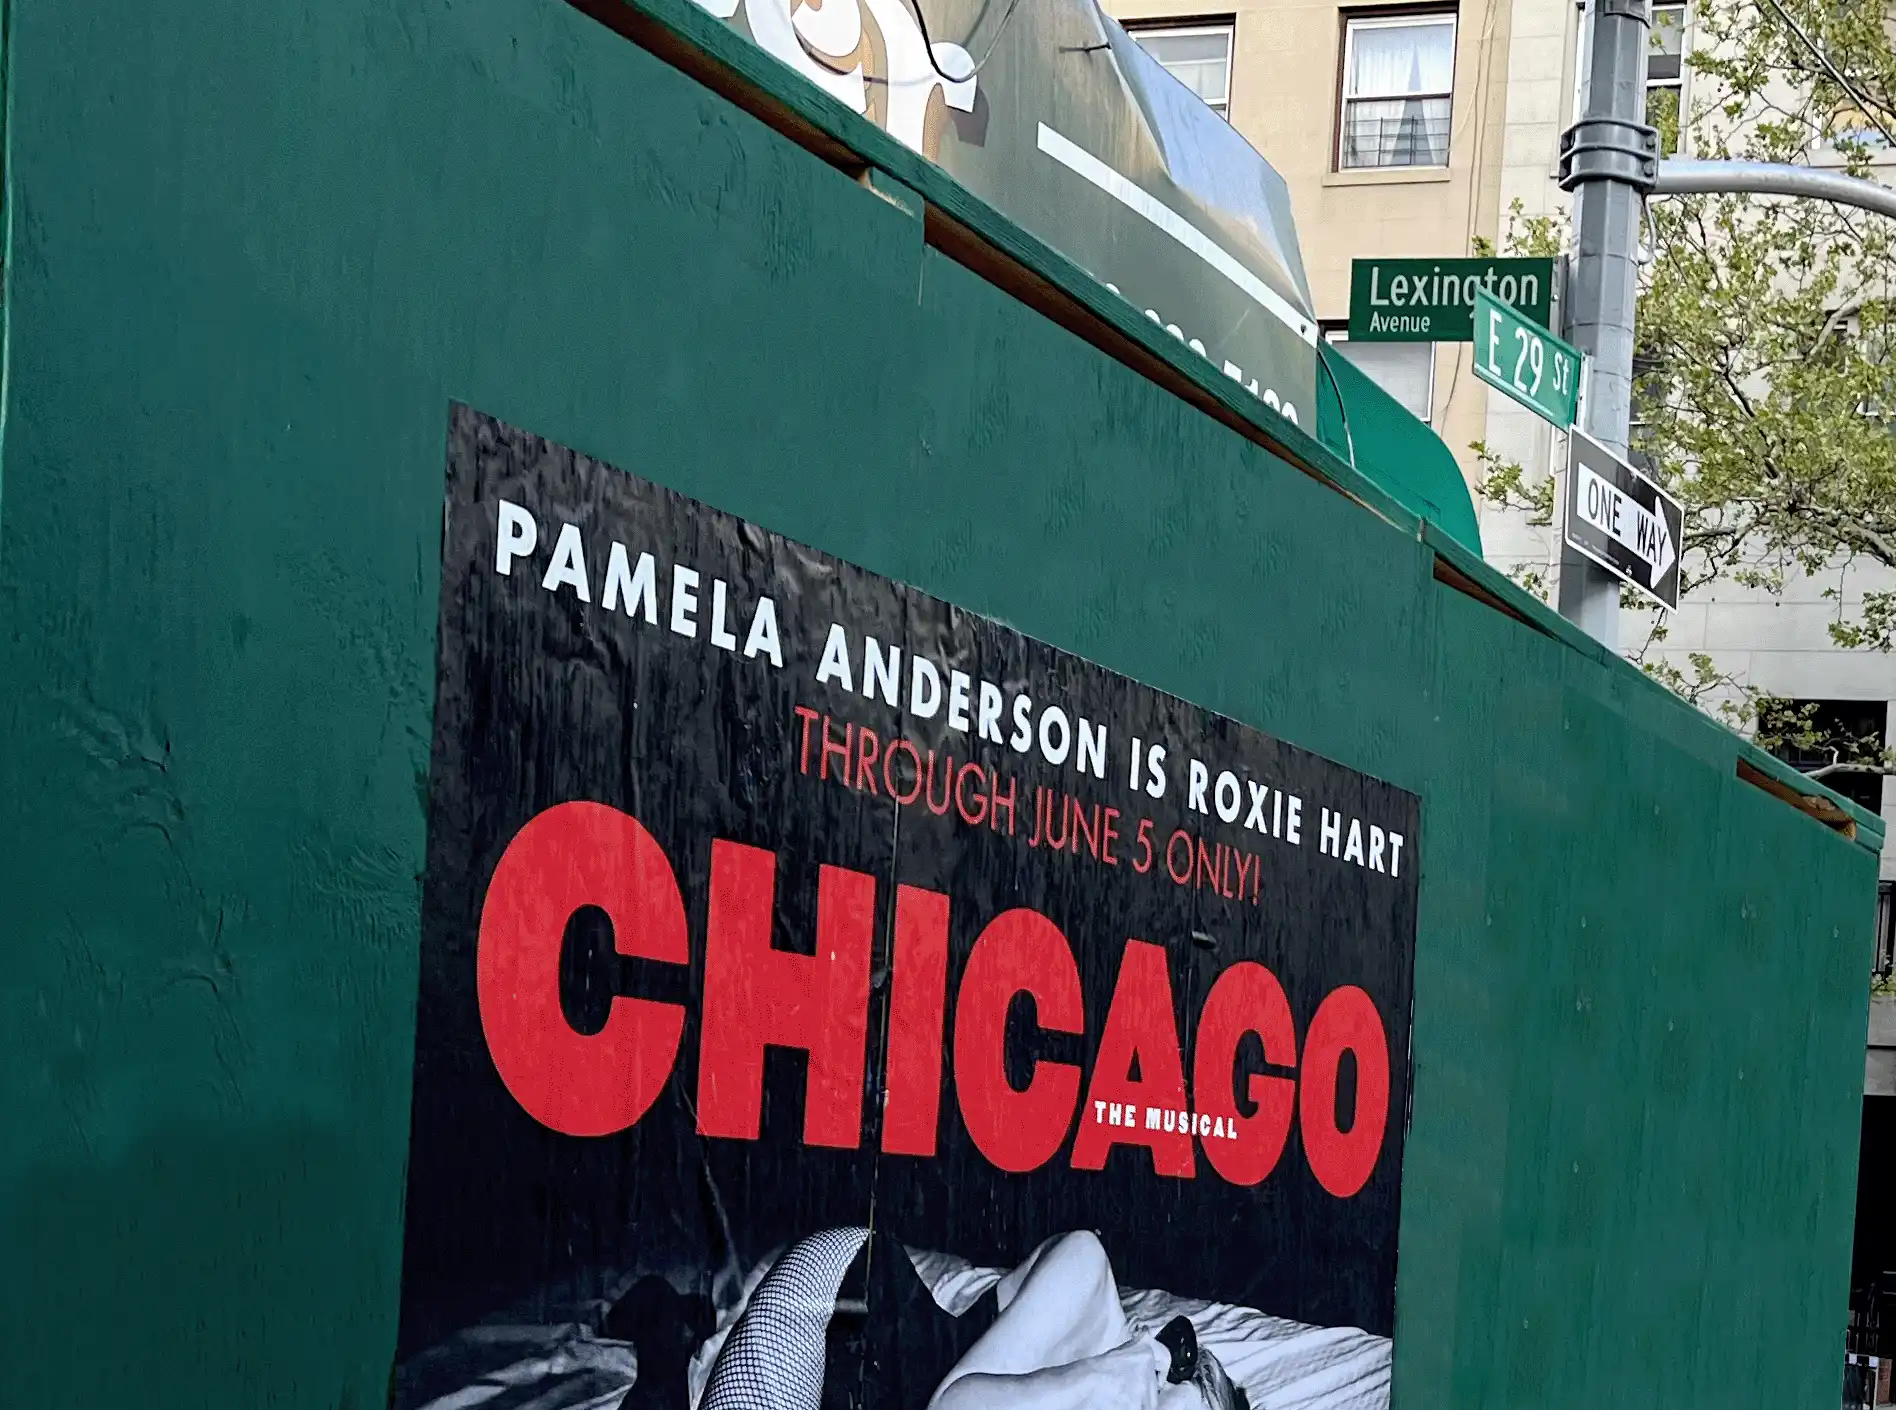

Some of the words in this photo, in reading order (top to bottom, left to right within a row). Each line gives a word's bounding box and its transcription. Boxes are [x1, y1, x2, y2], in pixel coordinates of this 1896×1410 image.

[1369, 311, 1431, 333] Avenue
[1488, 308, 1503, 377] E
[1513, 326, 1544, 398] 29
[1552, 352, 1571, 396] St
[1587, 476, 1622, 537] ONE
[1636, 511, 1668, 567] WAY
[496, 499, 784, 668] PAMELA
[816, 623, 1107, 780] ANDERSON
[1129, 737, 1167, 798] IS
[1188, 758, 1303, 846] ROXIE
[1319, 806, 1405, 879] HART
[795, 705, 1016, 836] THROUGH
[1028, 784, 1122, 868] JUNE
[1132, 819, 1153, 874] 5
[1167, 828, 1262, 907] ONLY!
[477, 801, 1390, 1197] CHICAGO
[1094, 1100, 1137, 1128] THE
[1145, 1107, 1238, 1140] MUSICAL
